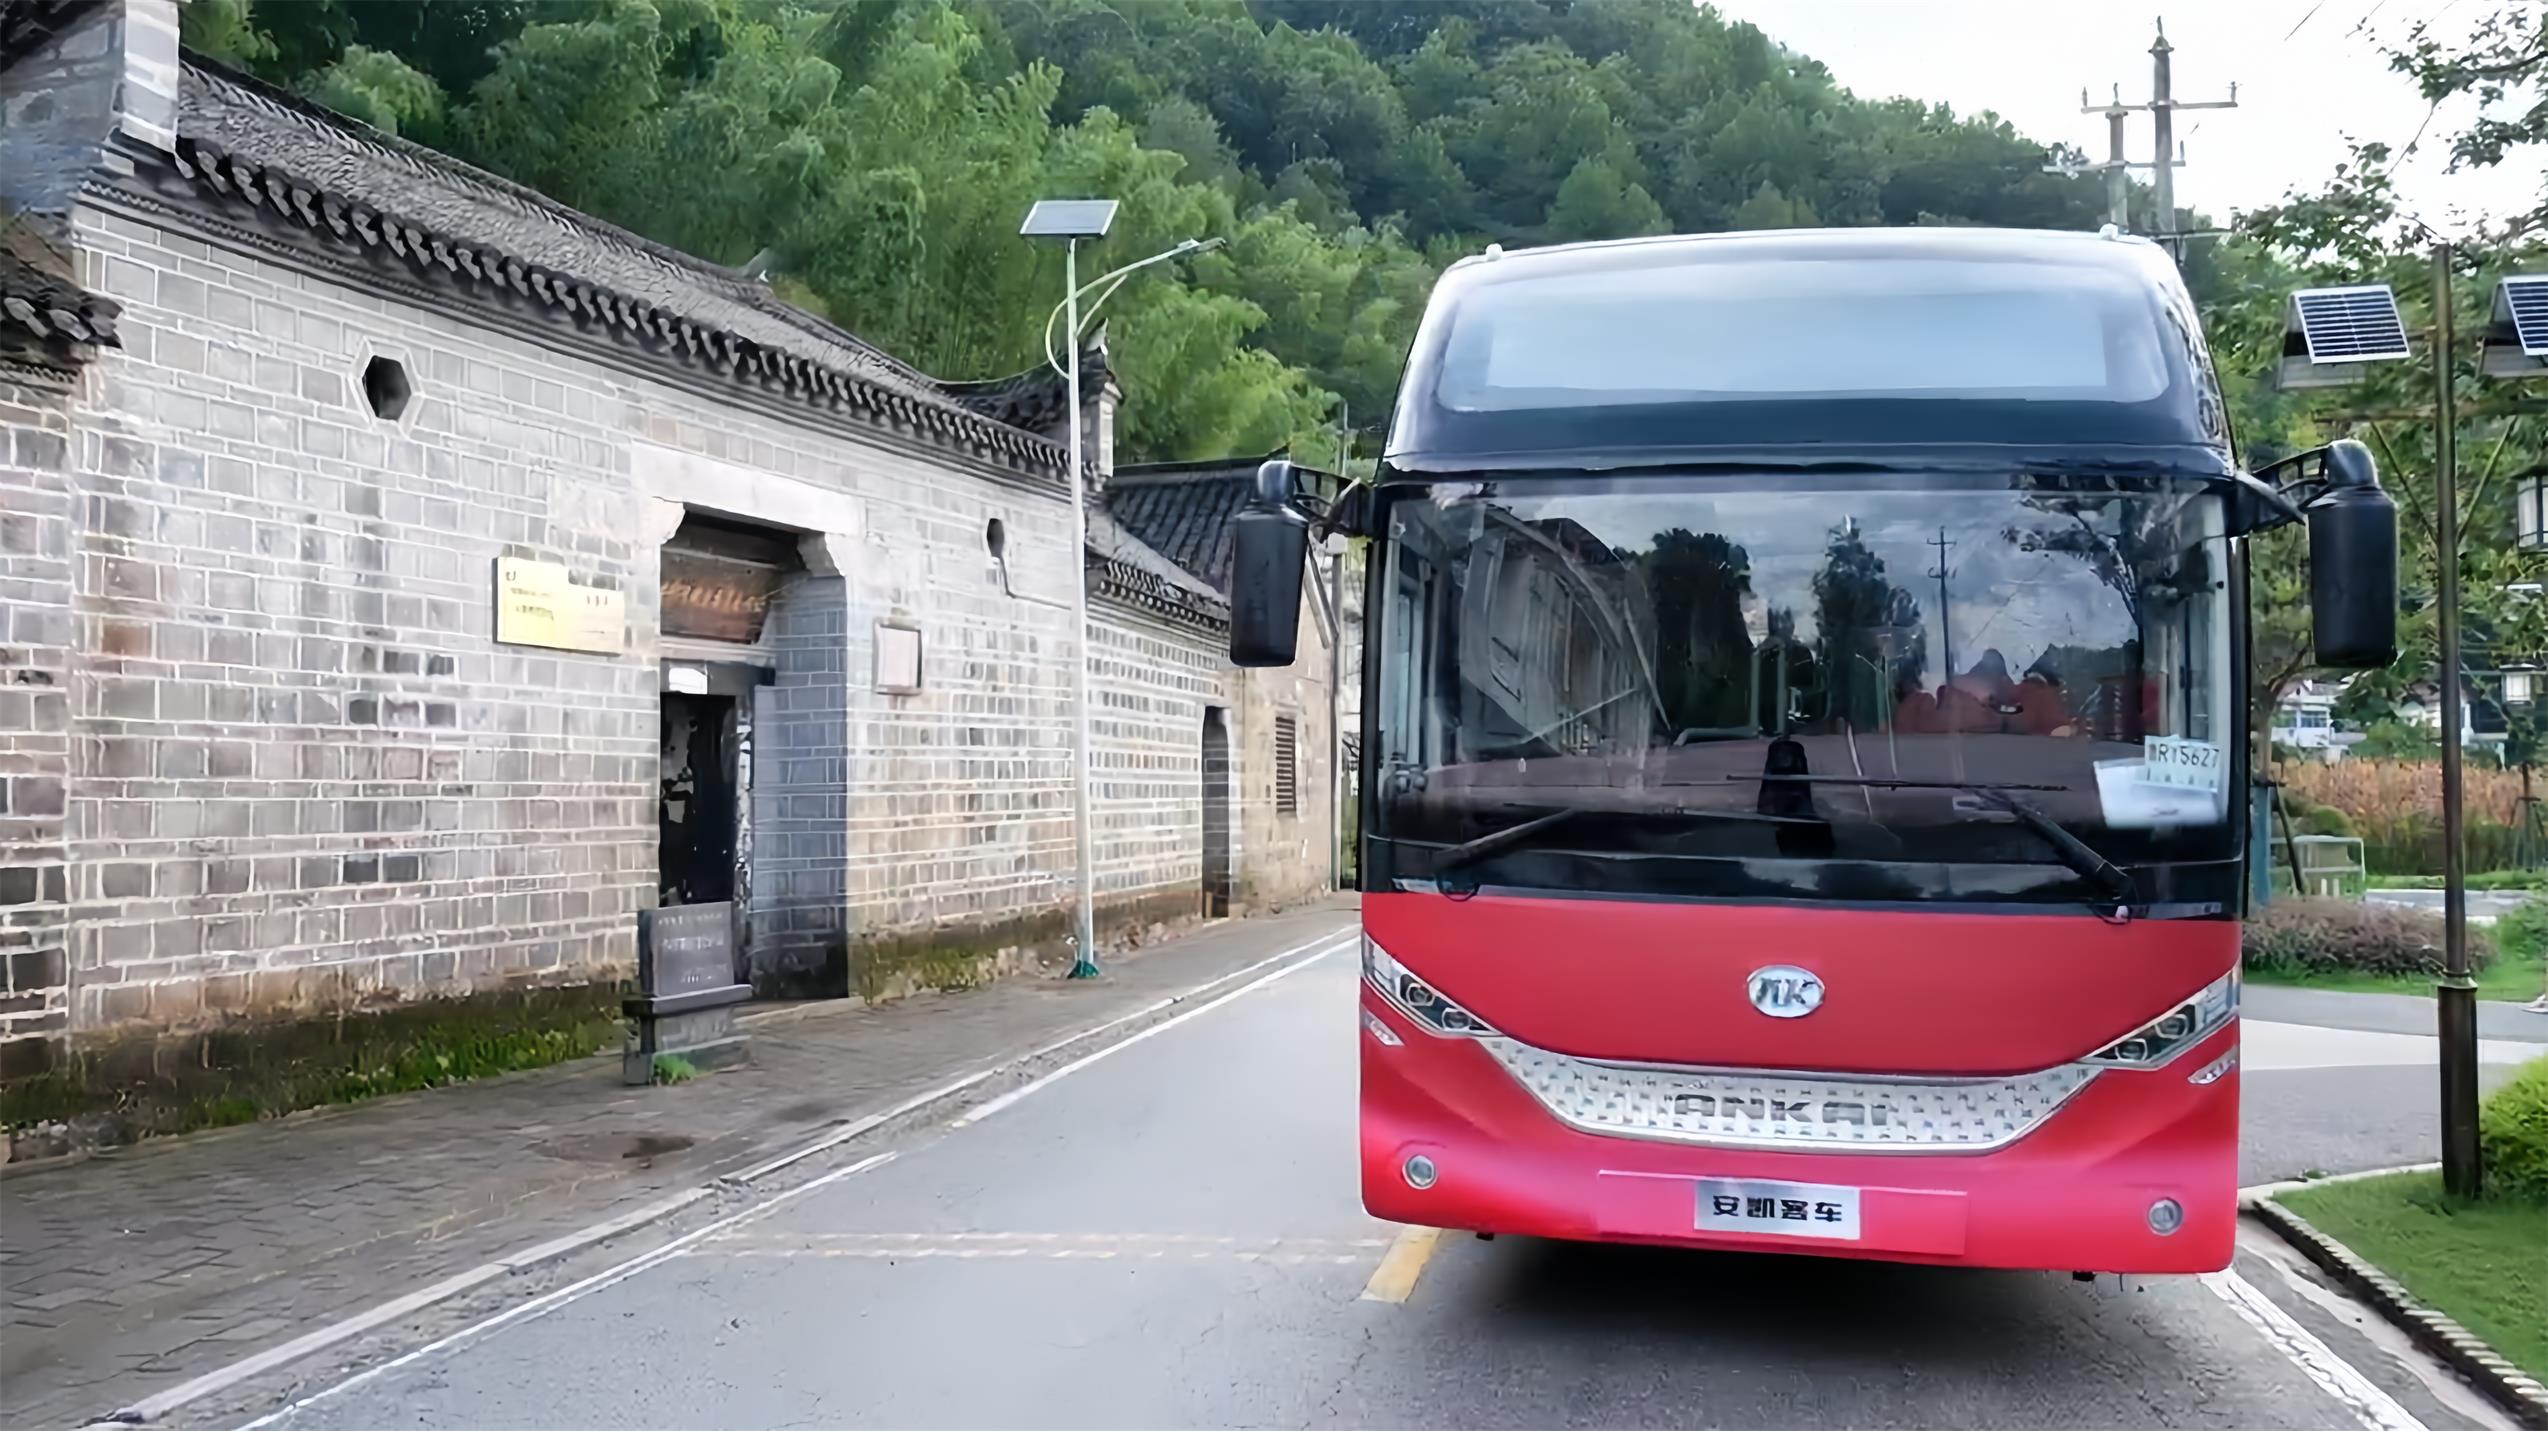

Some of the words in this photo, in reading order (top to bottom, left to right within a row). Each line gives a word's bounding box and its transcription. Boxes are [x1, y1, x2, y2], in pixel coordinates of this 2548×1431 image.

[1674, 1093, 1888, 1126] ANKAI
[1713, 1195, 1842, 1222] 安凯客车
